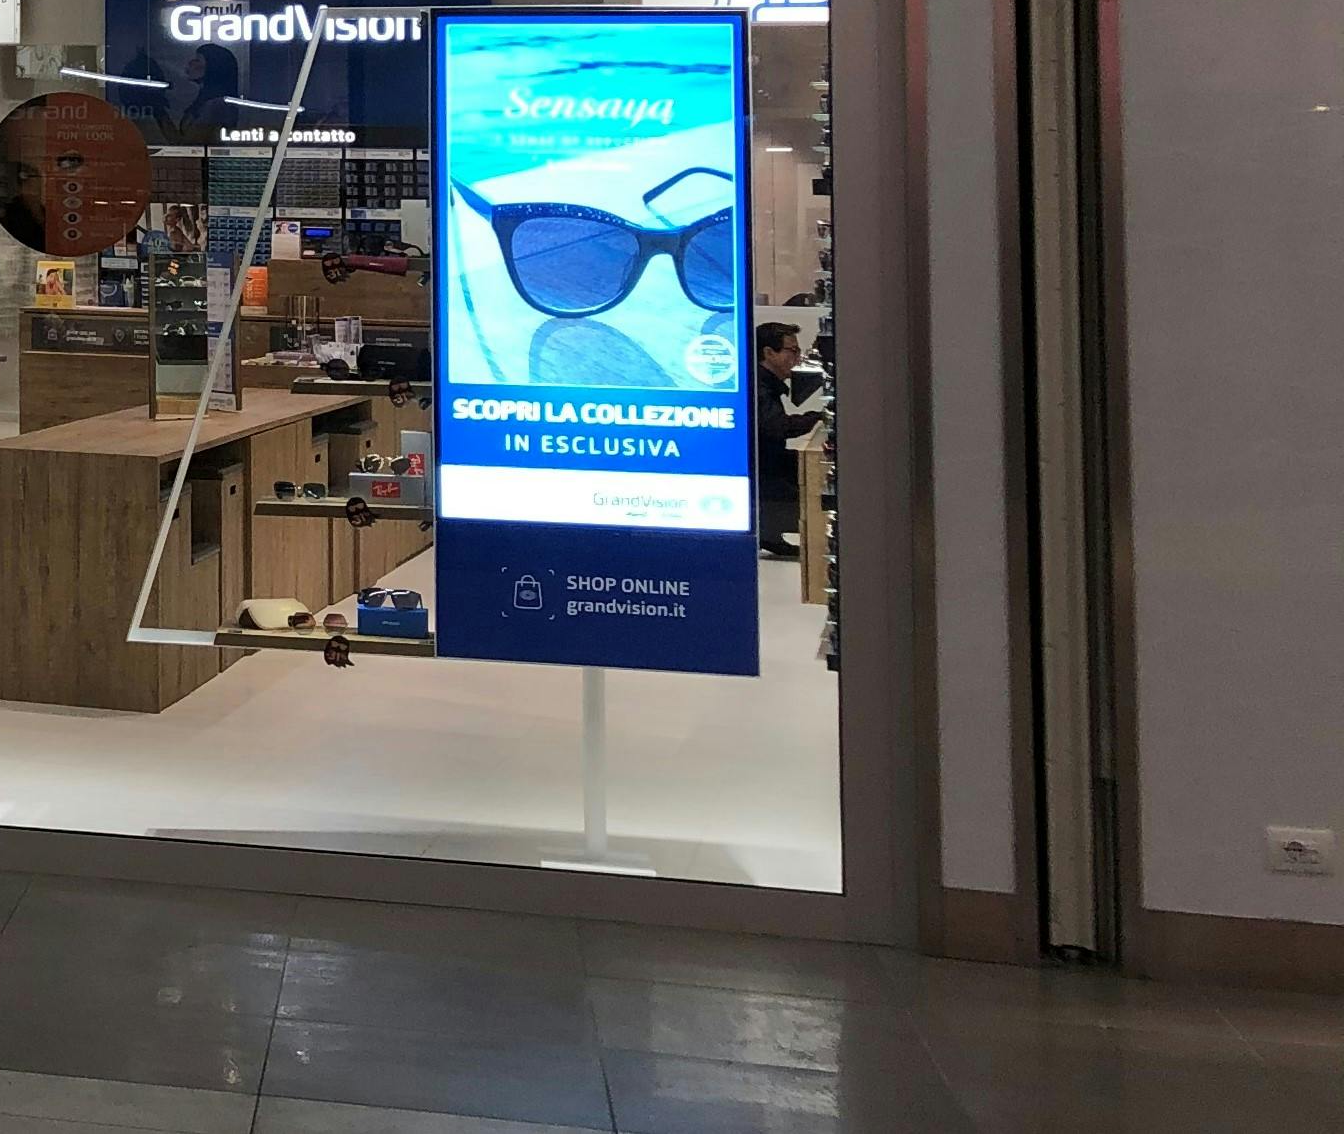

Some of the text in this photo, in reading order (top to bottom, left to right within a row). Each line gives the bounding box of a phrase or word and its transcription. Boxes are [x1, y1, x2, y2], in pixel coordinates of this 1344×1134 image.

[220, 127, 264, 142] Lenti
[453, 399, 735, 429] SCOPRI LA COLLEZIONE
[505, 434, 681, 457] IN ESCLUSIVA
[593, 491, 689, 509] GrandVision
[566, 575, 690, 596] SHOP ONLINE
[566, 599, 686, 618] grandvision.it
